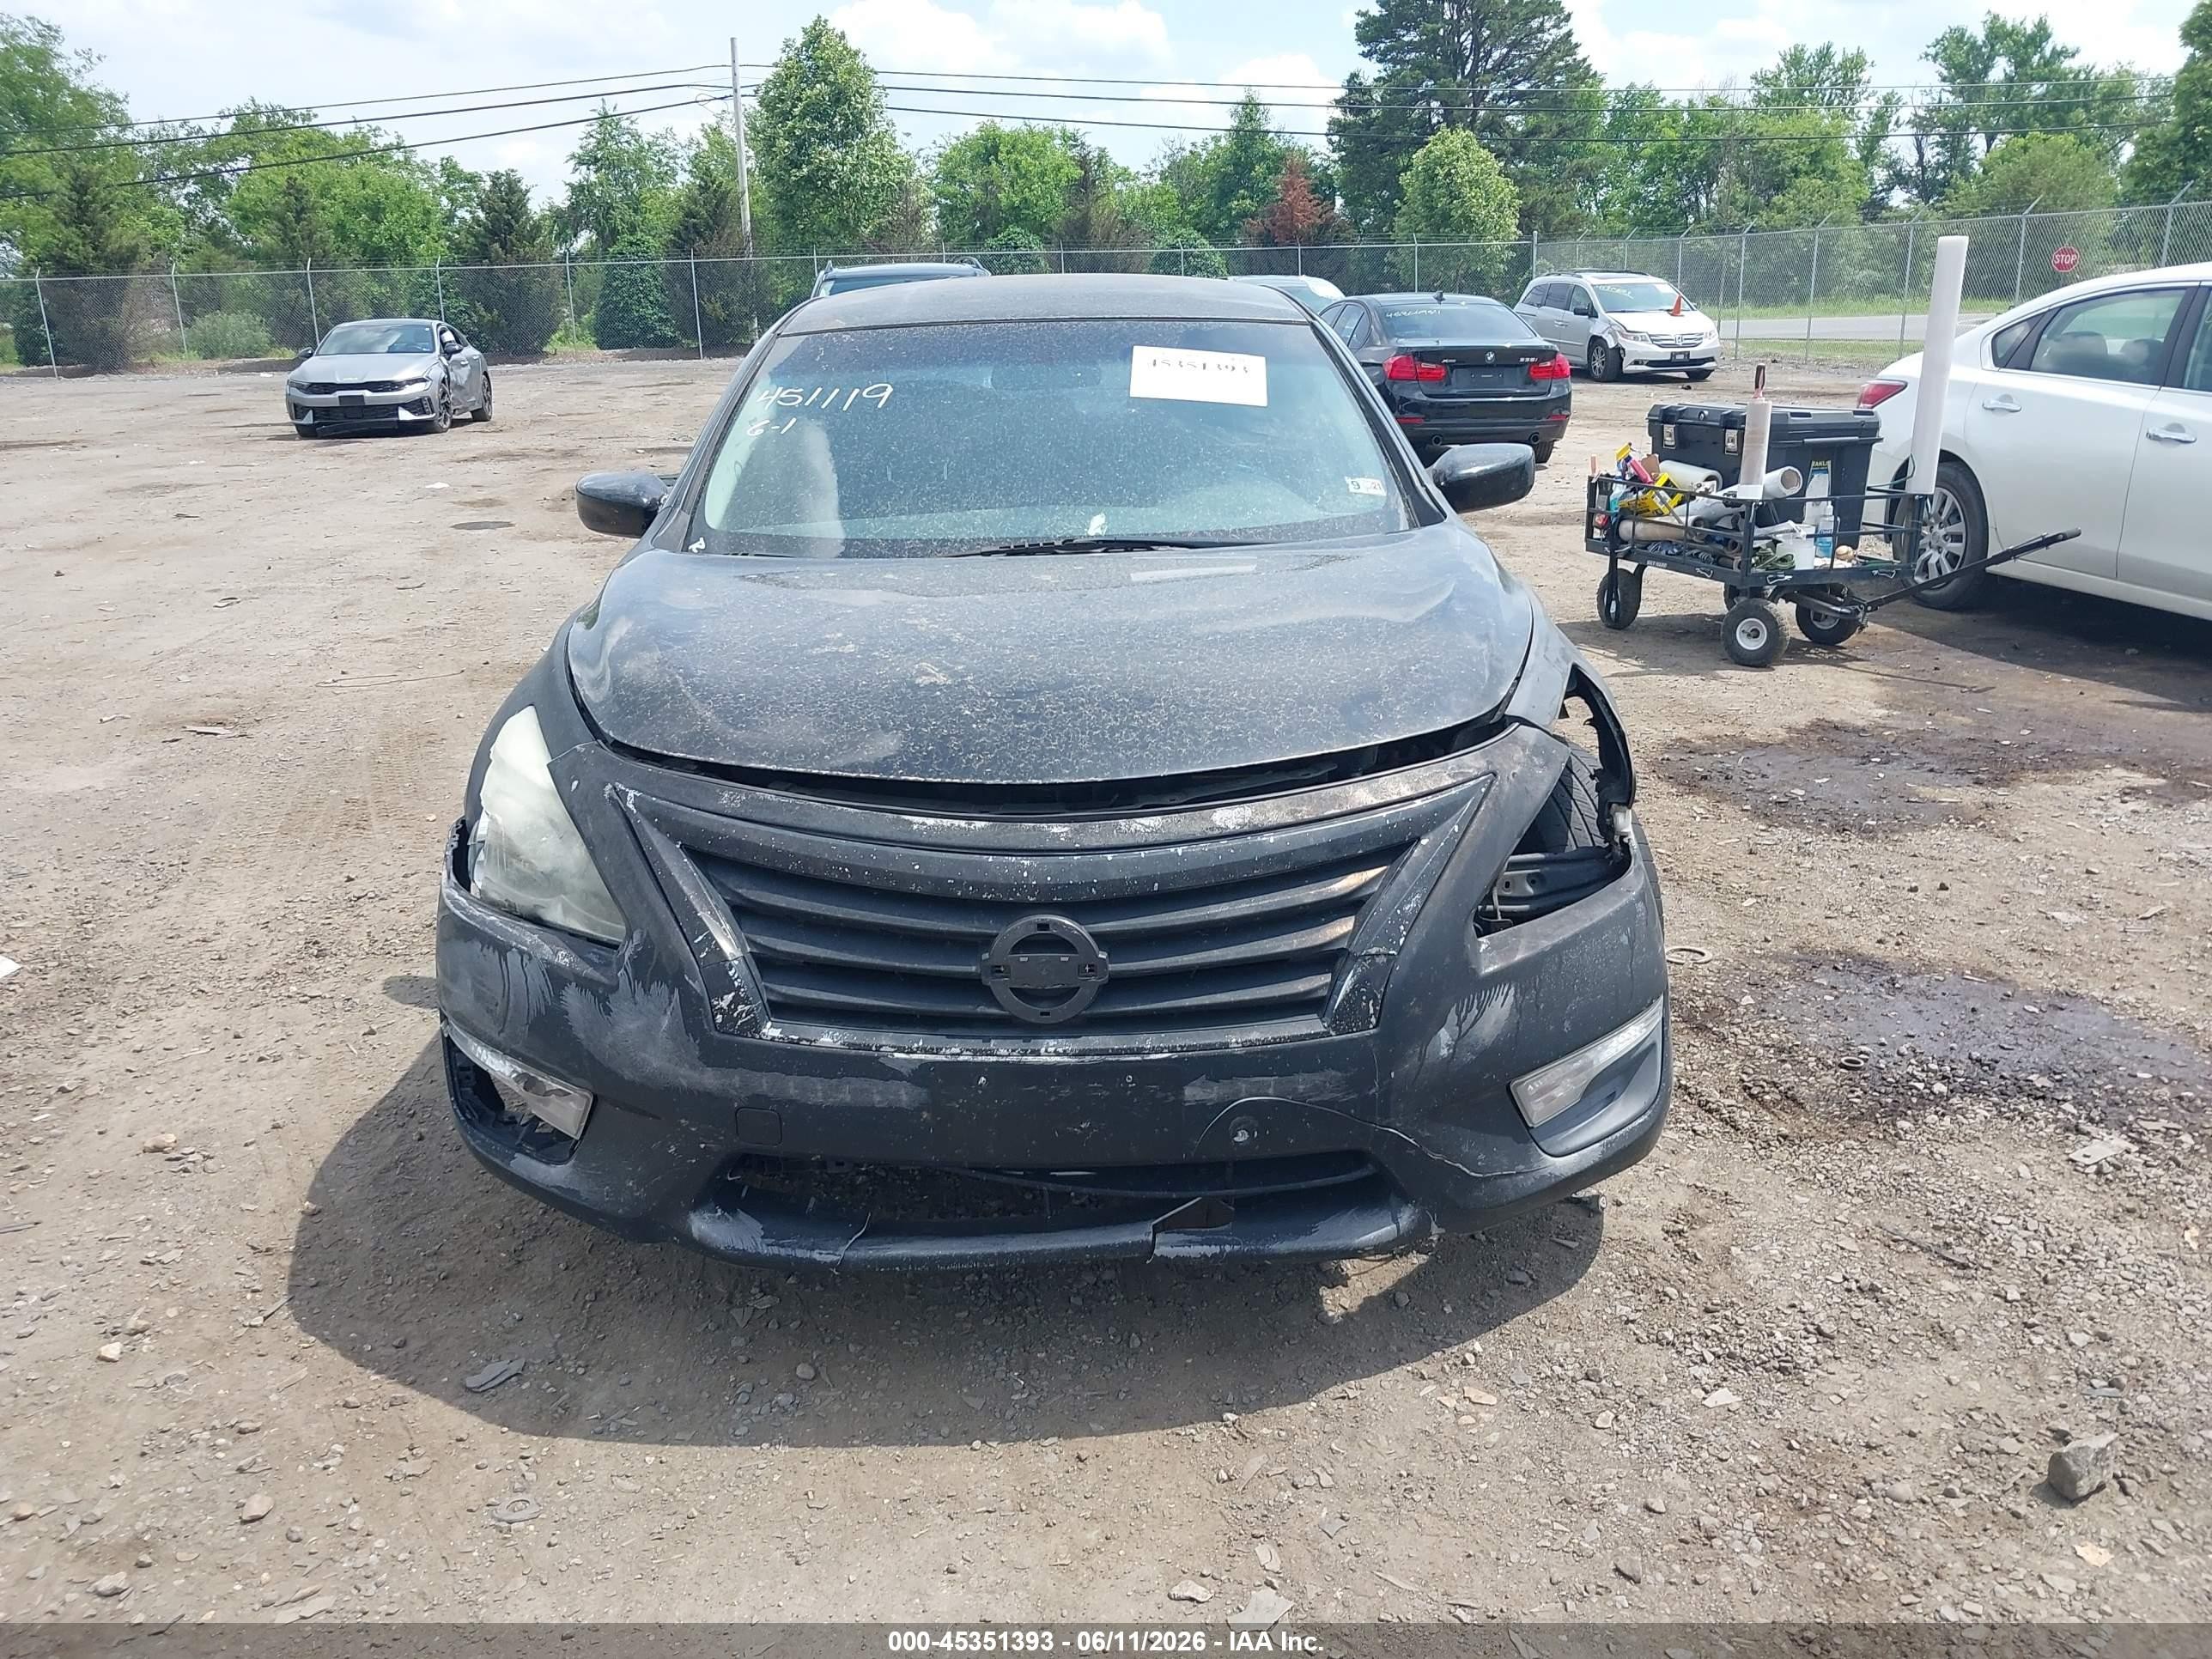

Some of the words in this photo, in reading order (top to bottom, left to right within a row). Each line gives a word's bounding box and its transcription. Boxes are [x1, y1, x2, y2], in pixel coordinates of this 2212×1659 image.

[2054, 254, 2077, 264] STOP
[756, 383, 894, 411] 451119
[746, 417, 797, 436] 6-1
[1351, 480, 1361, 490] 9
